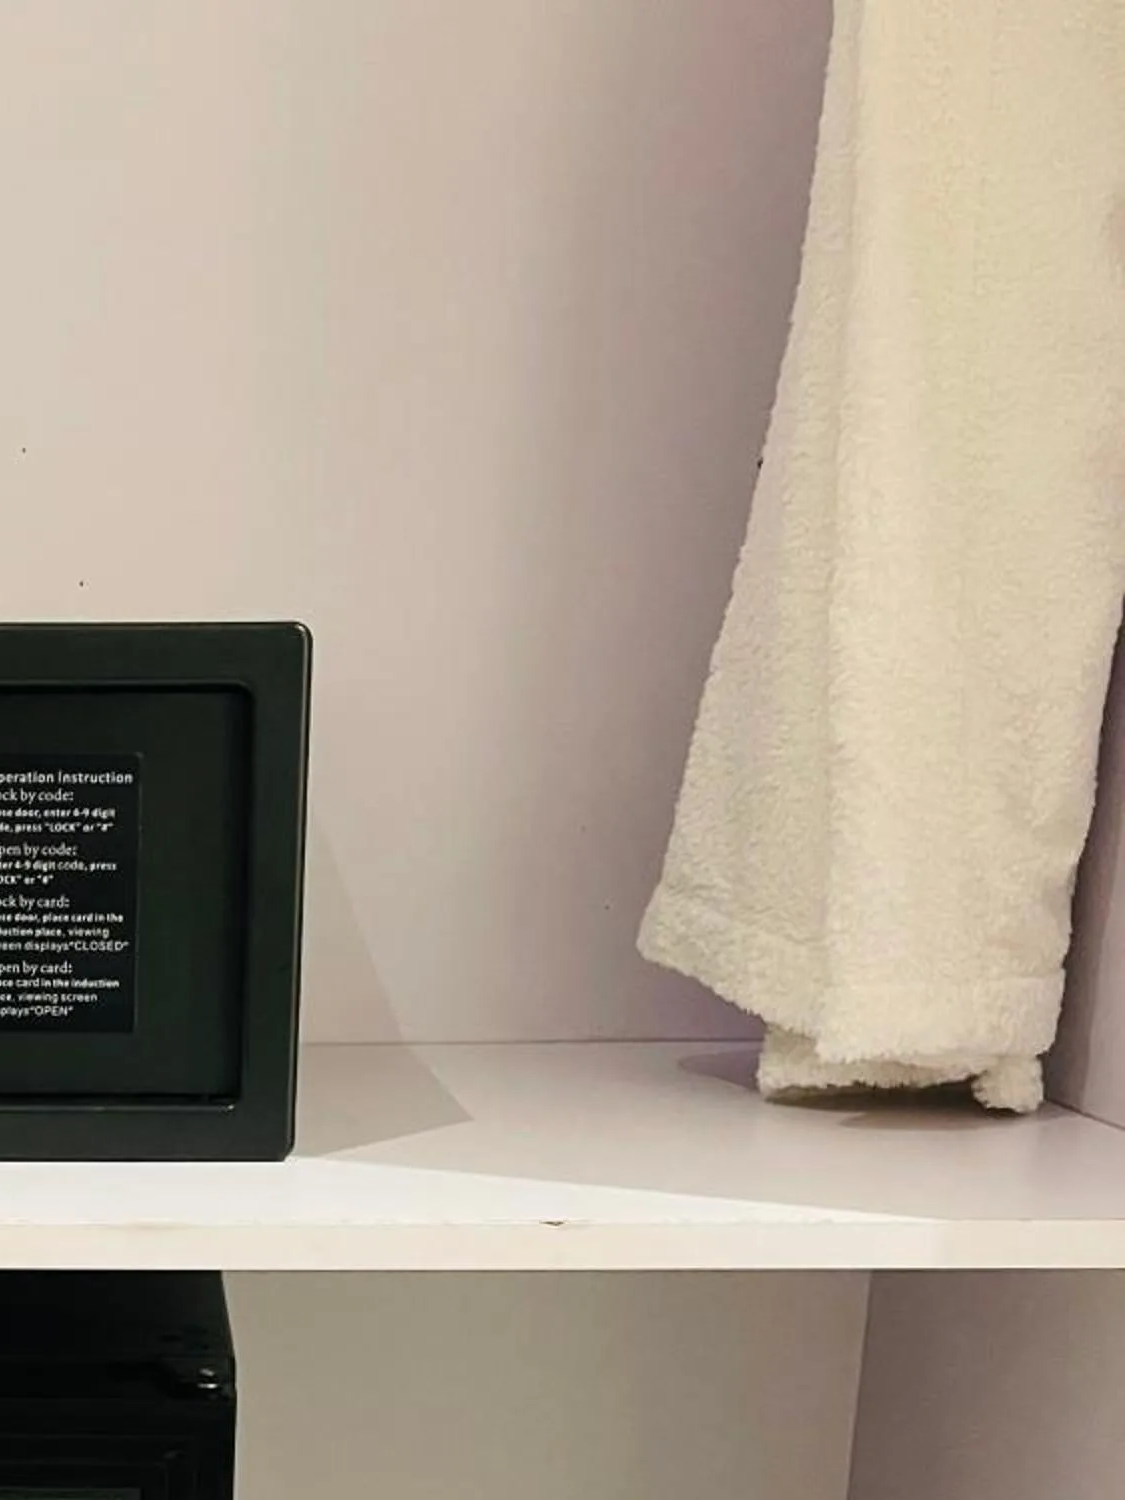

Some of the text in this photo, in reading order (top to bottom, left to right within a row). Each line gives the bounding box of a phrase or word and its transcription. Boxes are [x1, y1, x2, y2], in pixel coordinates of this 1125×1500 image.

[58, 770, 133, 783] Instruction
[21, 788, 36, 804] by
[38, 788, 74, 801] code:
[44, 809, 70, 817] enter
[15, 824, 42, 833] press
[24, 843, 39, 858] by
[41, 843, 77, 856] code:
[90, 862, 117, 871] press
[19, 894, 35, 911] by
[37, 895, 70, 908] card:
[42, 914, 69, 923] place
[71, 914, 93, 922] card
[106, 913, 123, 922] the
[68, 928, 110, 939] viewing
[22, 960, 38, 976] by
[40, 960, 73, 974] card:
[16, 978, 39, 987] card
[53, 978, 69, 987] the
[18, 994, 59, 1003] viewing
[61, 994, 97, 1002] screen
